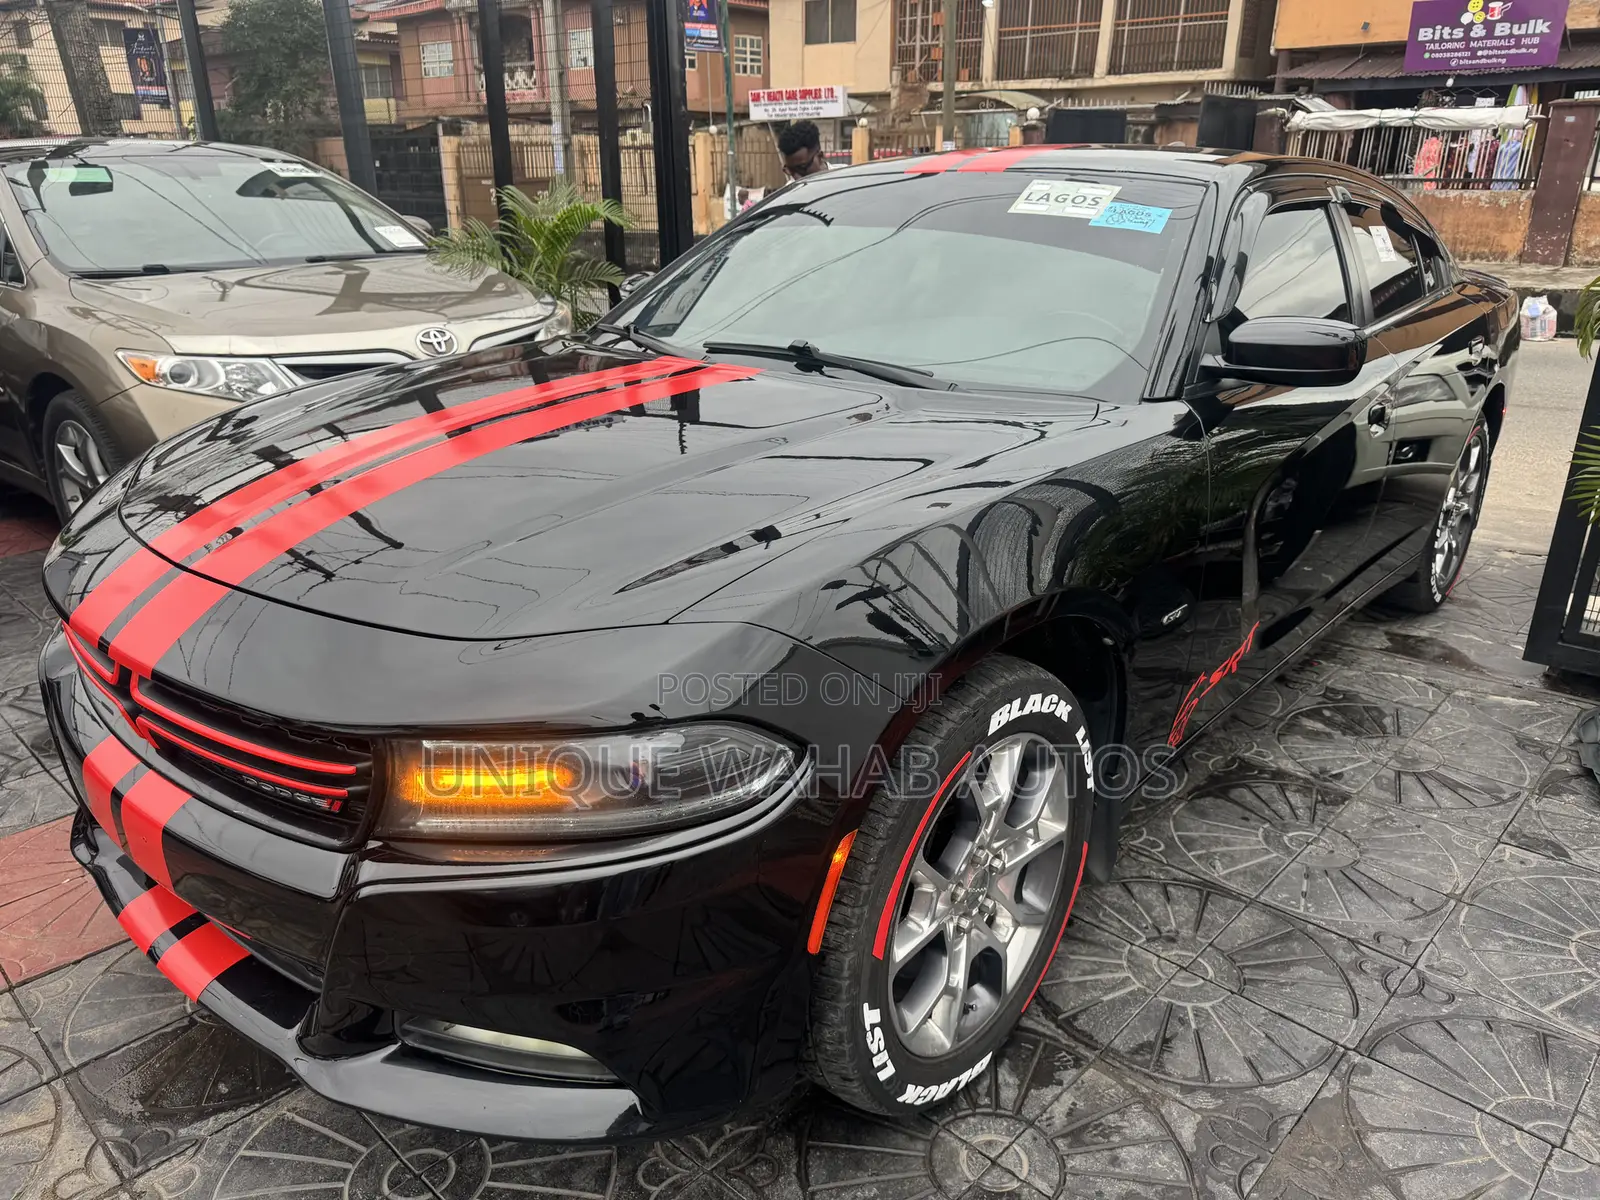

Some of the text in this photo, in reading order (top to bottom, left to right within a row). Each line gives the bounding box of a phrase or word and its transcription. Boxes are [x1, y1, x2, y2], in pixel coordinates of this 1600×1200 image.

[1417, 19, 1552, 41] Bits & Bulk
[1425, 36, 1540, 50] TAILORING MATERIALS HUB
[785, 89, 797, 101] CARE
[799, 87, 822, 100] SUPPLIES
[1024, 191, 1103, 207] LAGOS
[987, 693, 1095, 792] BLACK LIST
[241, 774, 331, 809] DODGE
[863, 1002, 993, 1105] BLACK LIST
